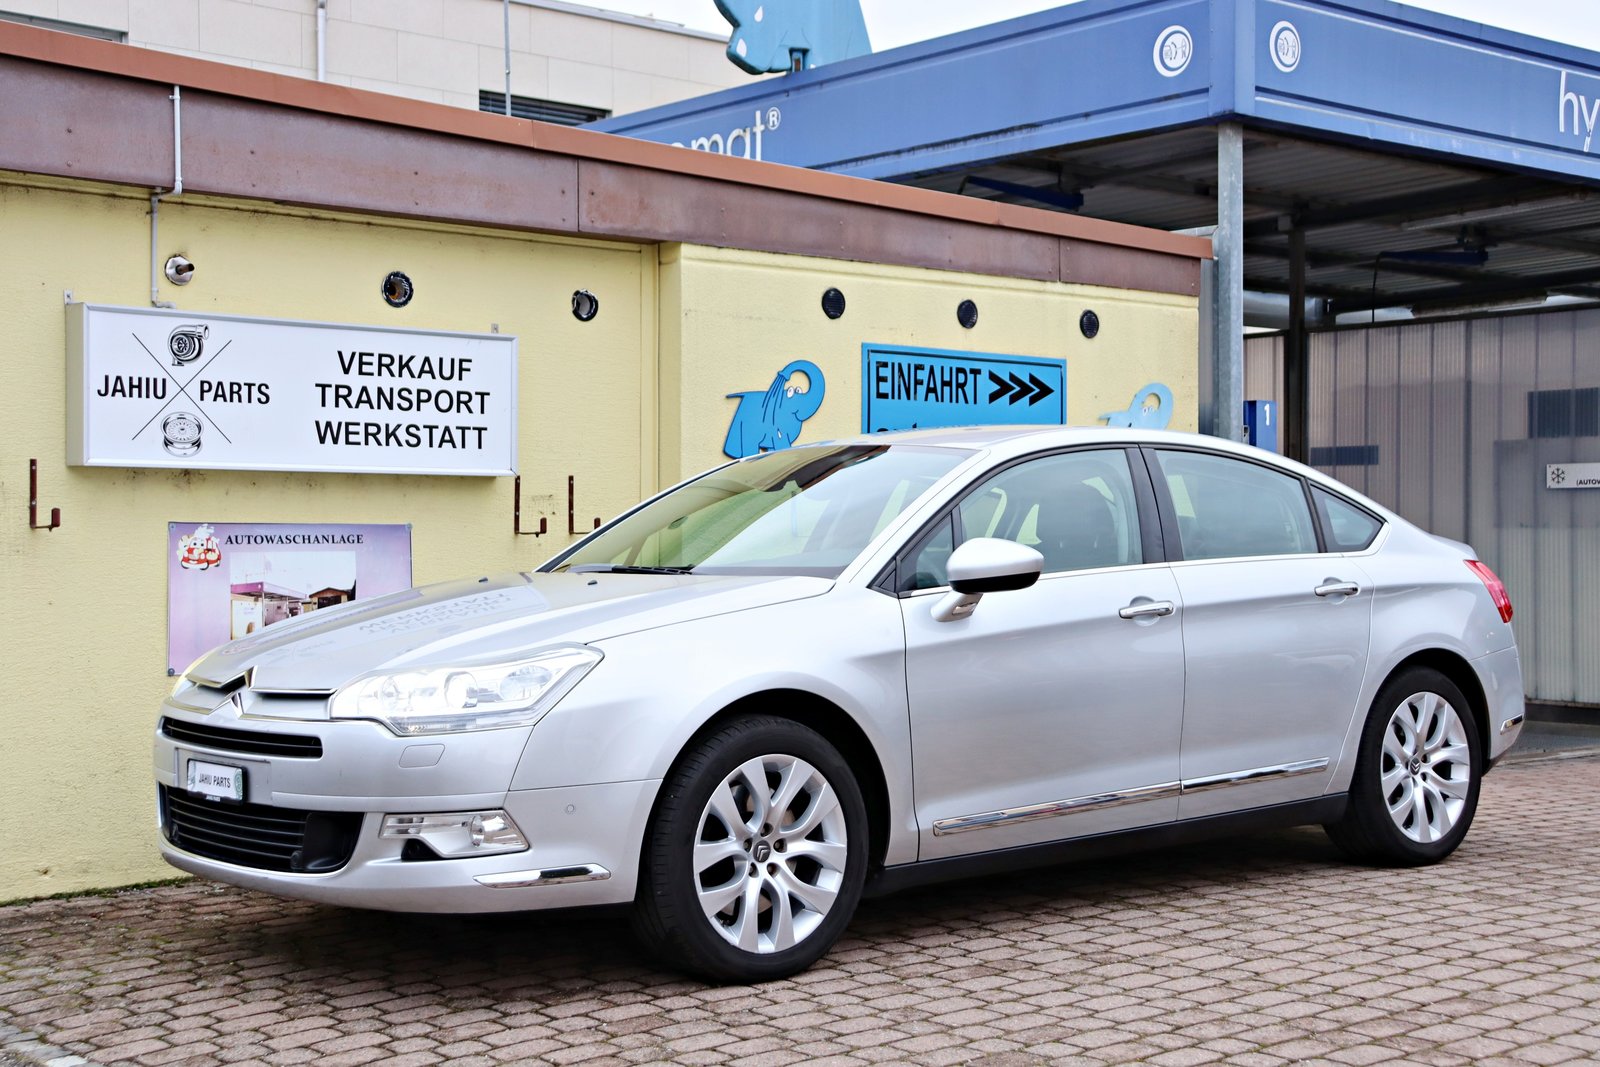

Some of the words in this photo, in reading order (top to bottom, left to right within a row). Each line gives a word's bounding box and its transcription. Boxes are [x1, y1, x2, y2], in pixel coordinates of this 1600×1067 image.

[336, 350, 473, 382] VERKAUF
[97, 374, 168, 401] JAHIU
[199, 379, 271, 405] PARTS
[875, 360, 982, 405] EINFAHRT
[315, 383, 490, 415] TRANSPORT
[1264, 403, 1270, 426] 1
[315, 420, 488, 450] WERKSTATT
[225, 534, 364, 545] AUTOWASCHANLAGE
[199, 773, 212, 785] JAHIU
[213, 775, 231, 788] PARTS
